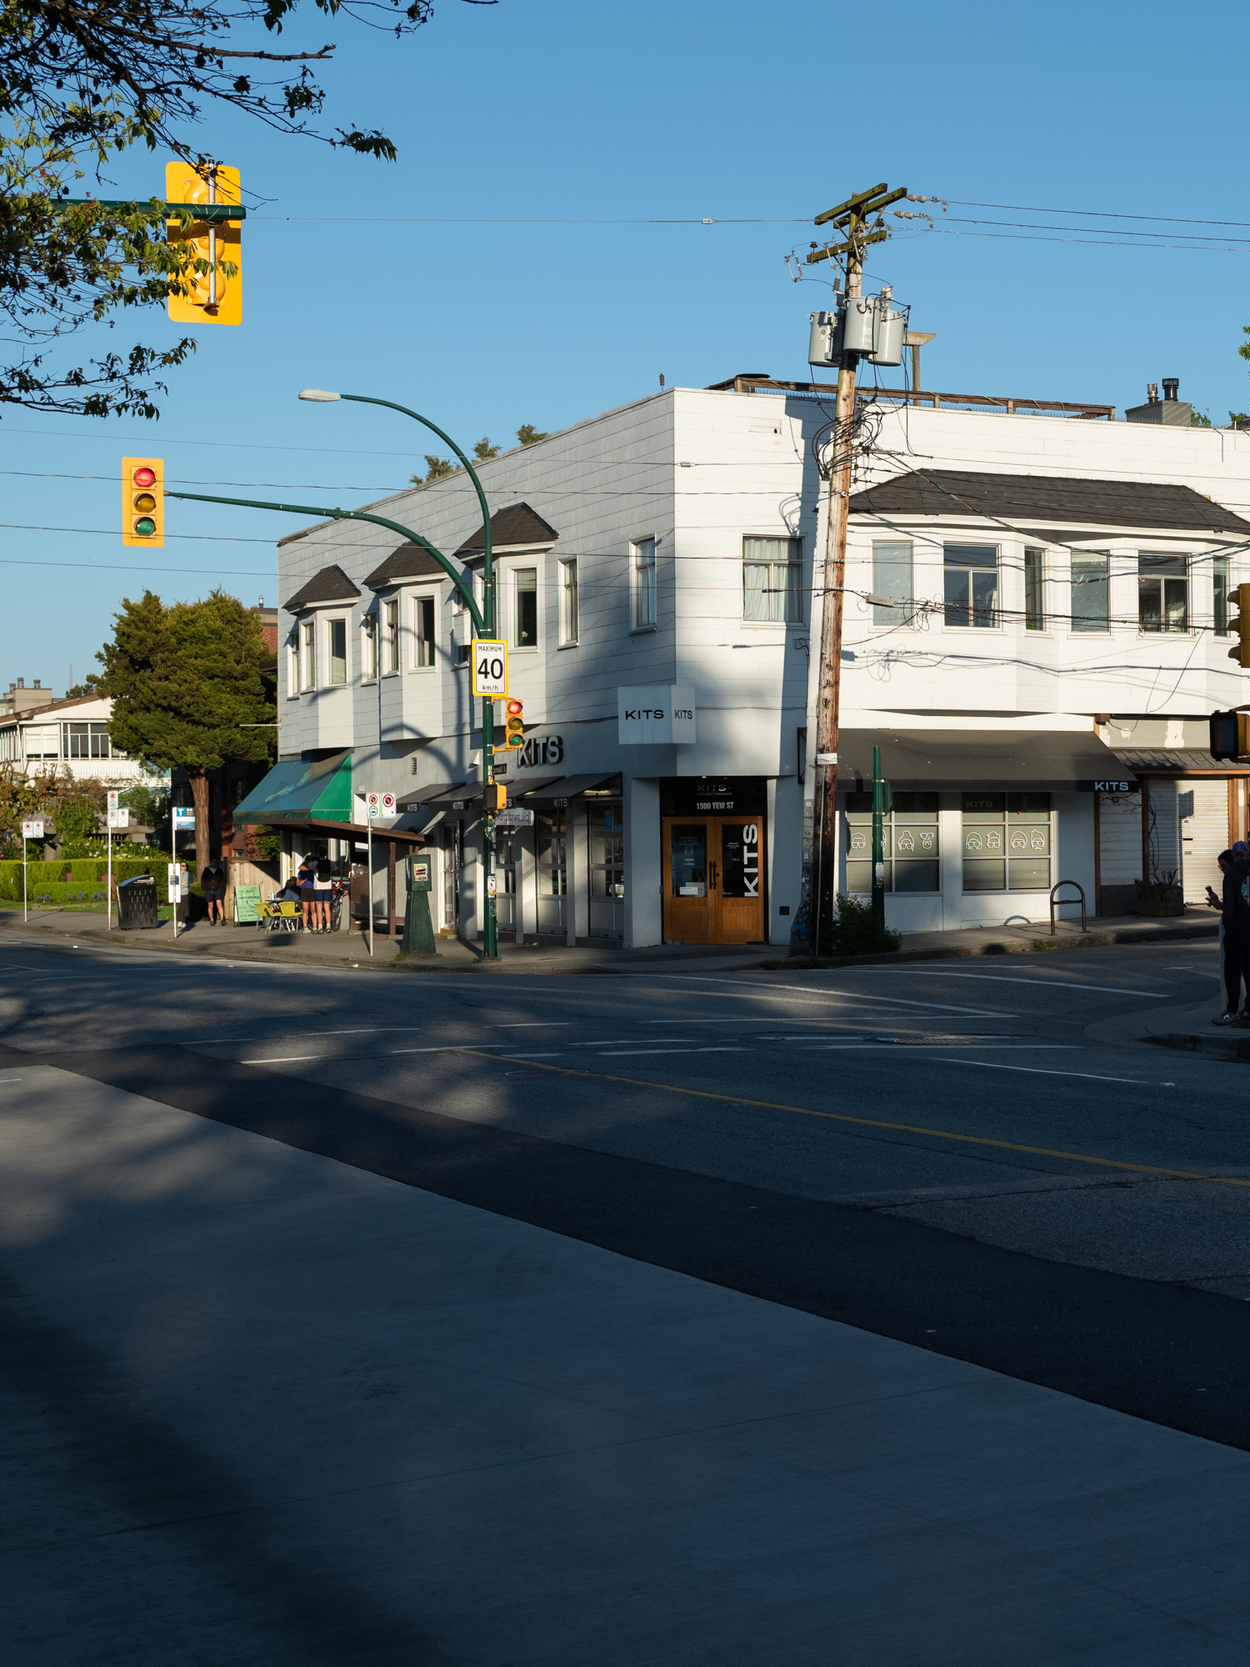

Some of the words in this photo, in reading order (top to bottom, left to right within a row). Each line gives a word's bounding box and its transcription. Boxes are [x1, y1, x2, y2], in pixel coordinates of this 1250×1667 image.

[477, 658, 504, 680] 40
[625, 709, 665, 720] KITS
[674, 709, 693, 720] KITS
[517, 736, 562, 767] KITS
[697, 784, 727, 792] KITS
[1094, 781, 1130, 791] KITS
[407, 803, 418, 812] KITS
[452, 801, 465, 810] KITS
[553, 798, 568, 808] KITS
[696, 802, 712, 810] 1500
[712, 801, 725, 810] YEW
[726, 801, 735, 809] ST
[966, 800, 994, 809] KITS
[742, 824, 759, 897] KITS
